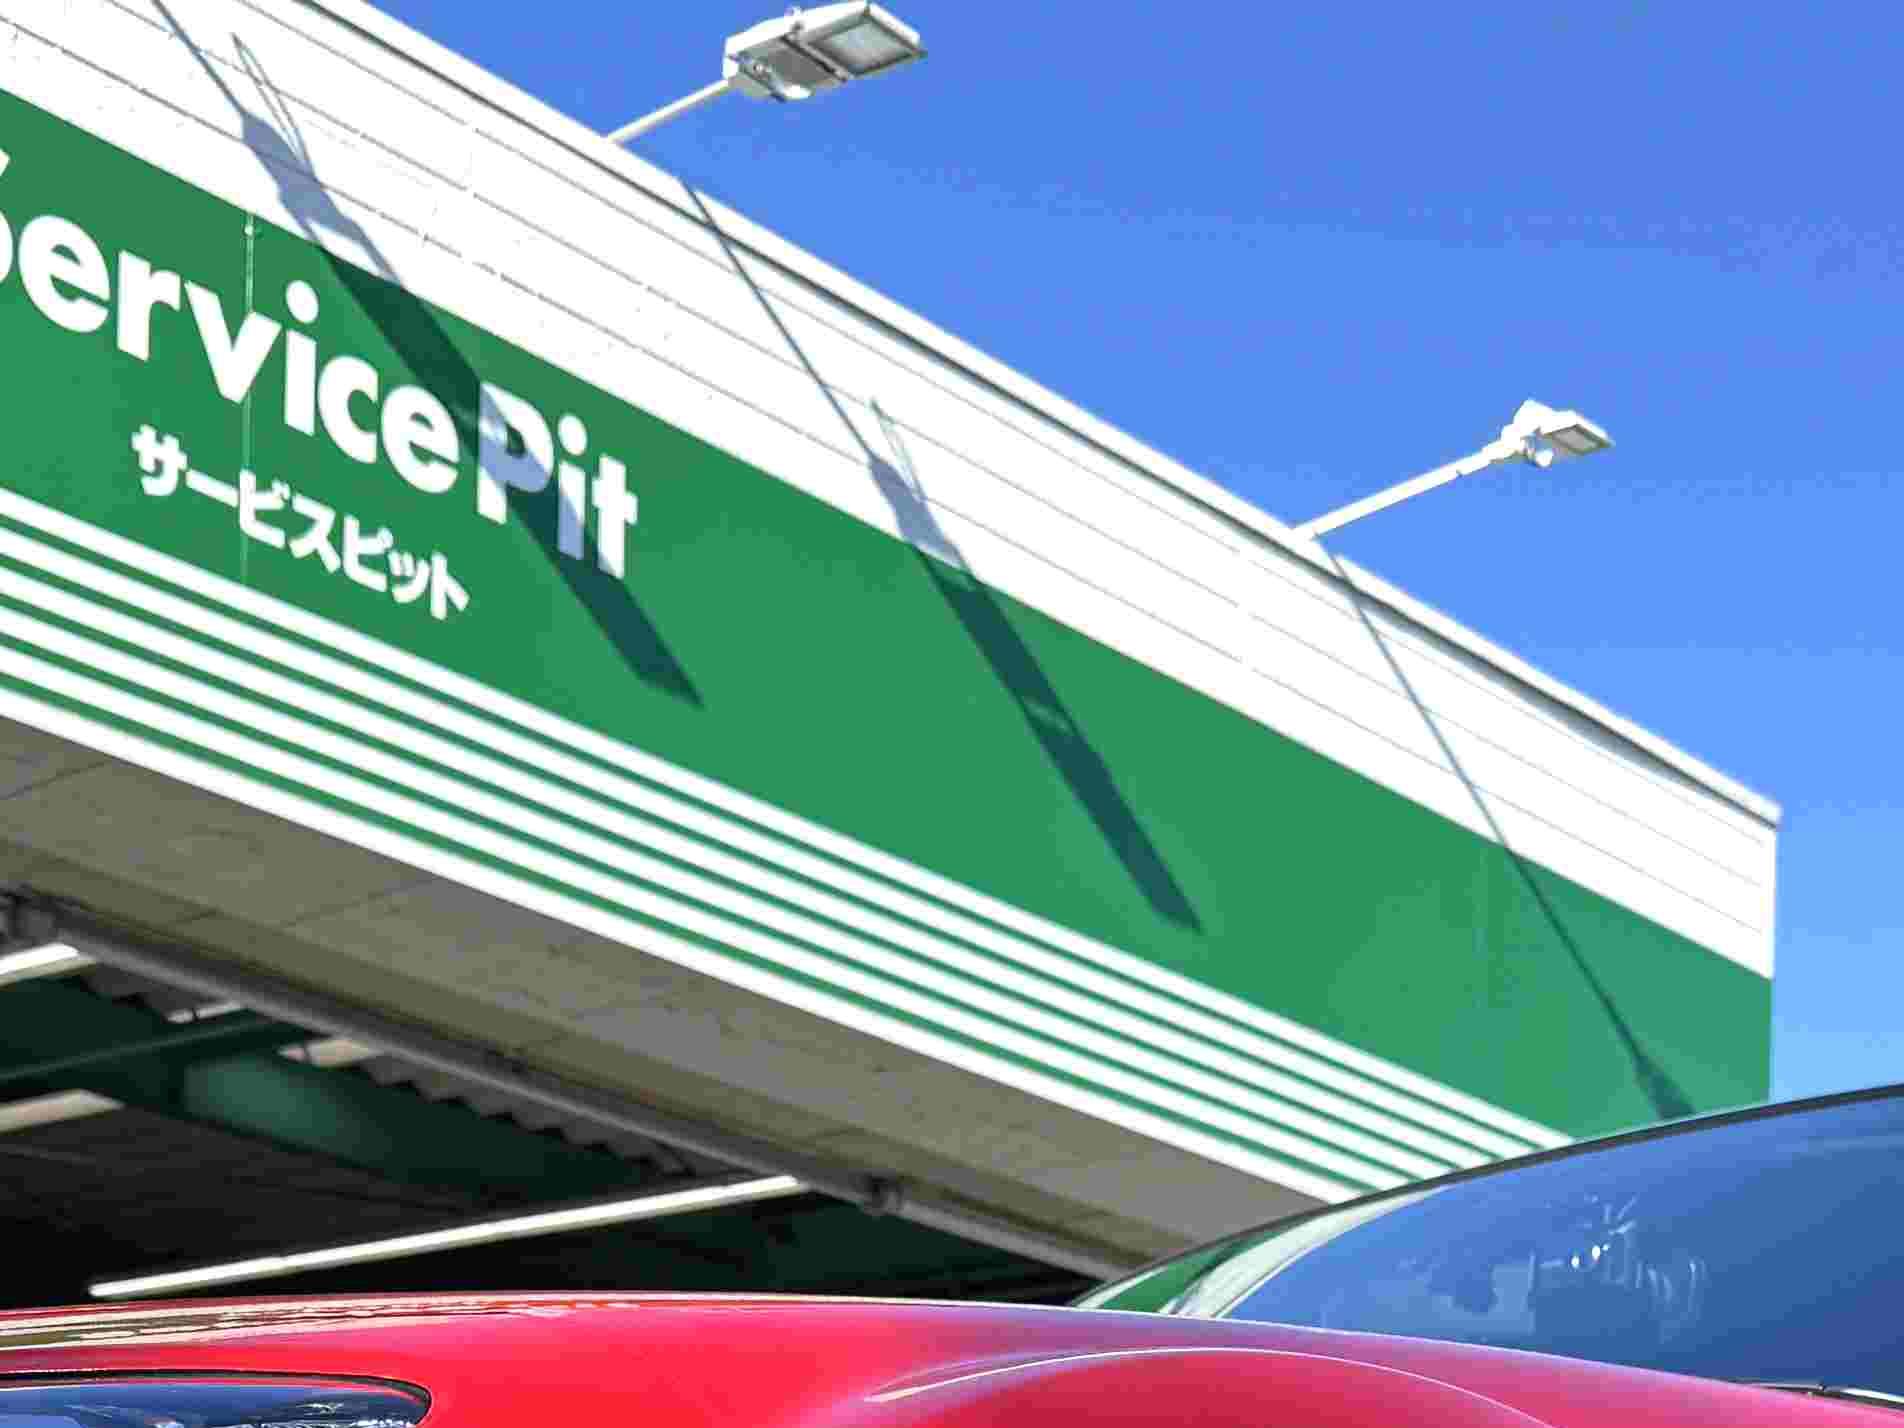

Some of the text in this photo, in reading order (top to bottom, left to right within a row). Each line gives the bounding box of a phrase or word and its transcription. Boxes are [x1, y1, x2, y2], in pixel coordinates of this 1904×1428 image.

[131, 424, 470, 619] サービスピット
